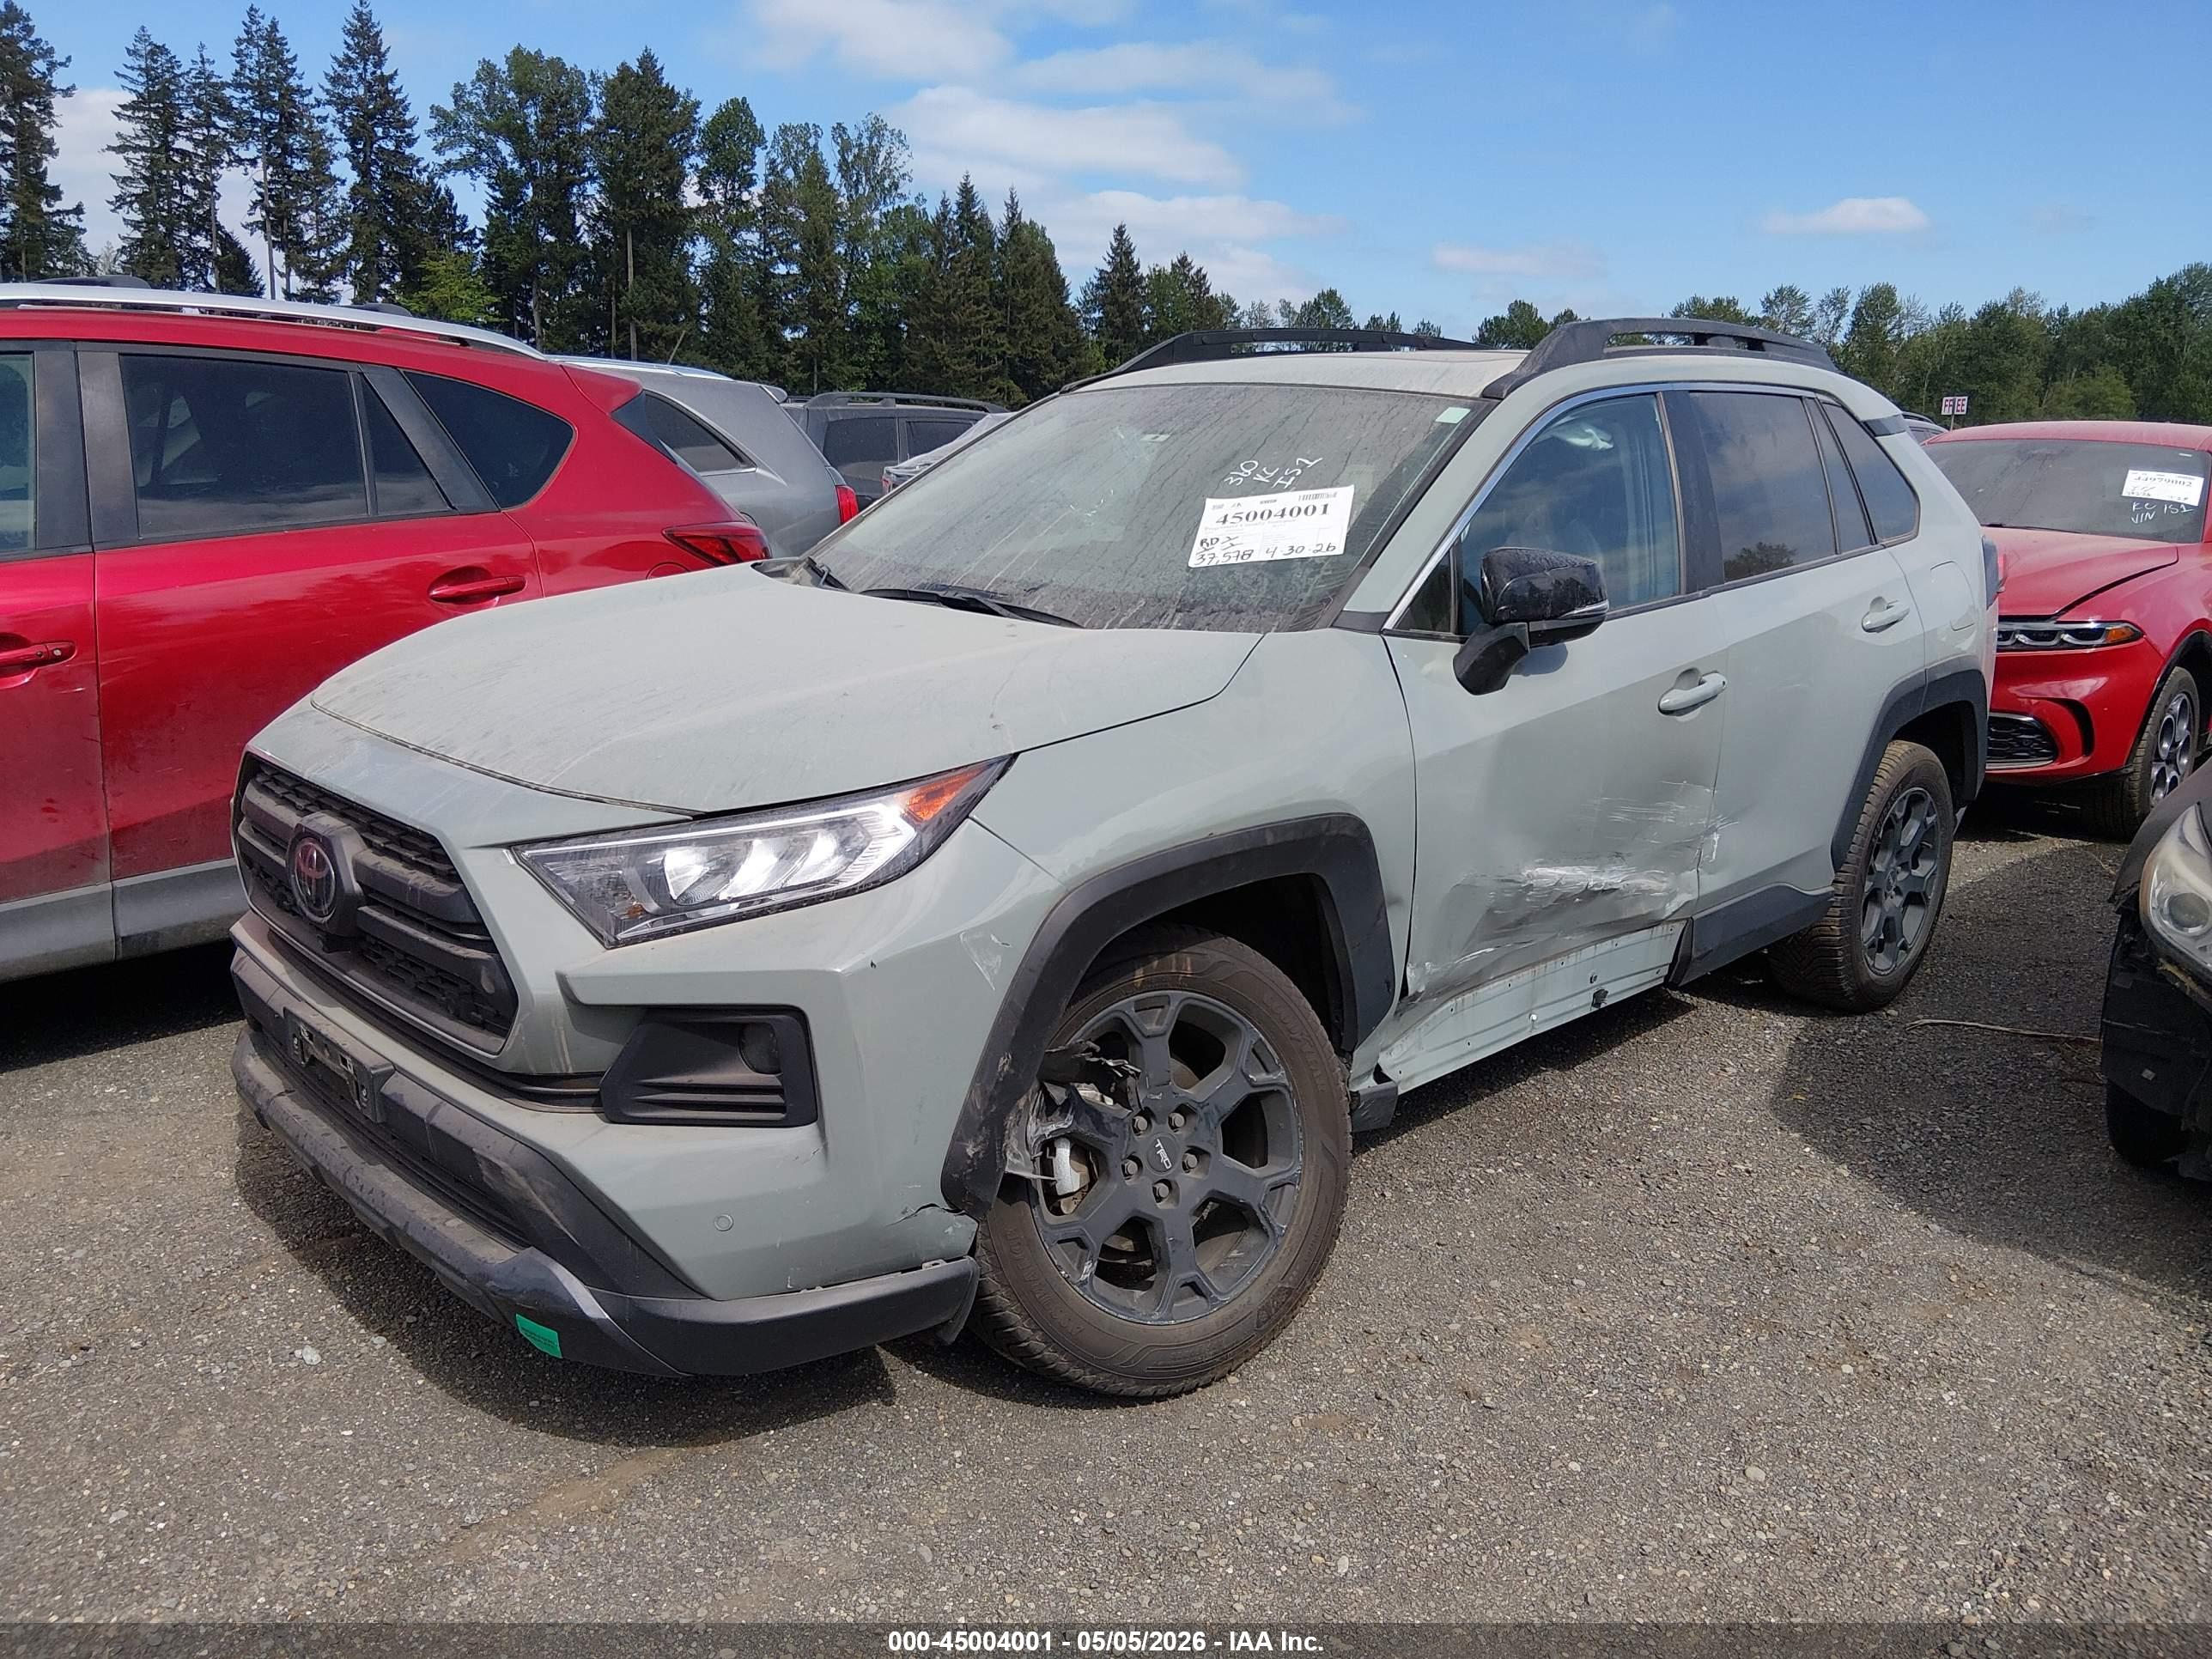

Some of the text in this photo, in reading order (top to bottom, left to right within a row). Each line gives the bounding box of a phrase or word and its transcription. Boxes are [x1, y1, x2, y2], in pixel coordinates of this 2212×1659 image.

[1215, 503, 1328, 525] 45004001
[2131, 511, 2156, 524] VIN
[1154, 1138, 1172, 1170] TRD
